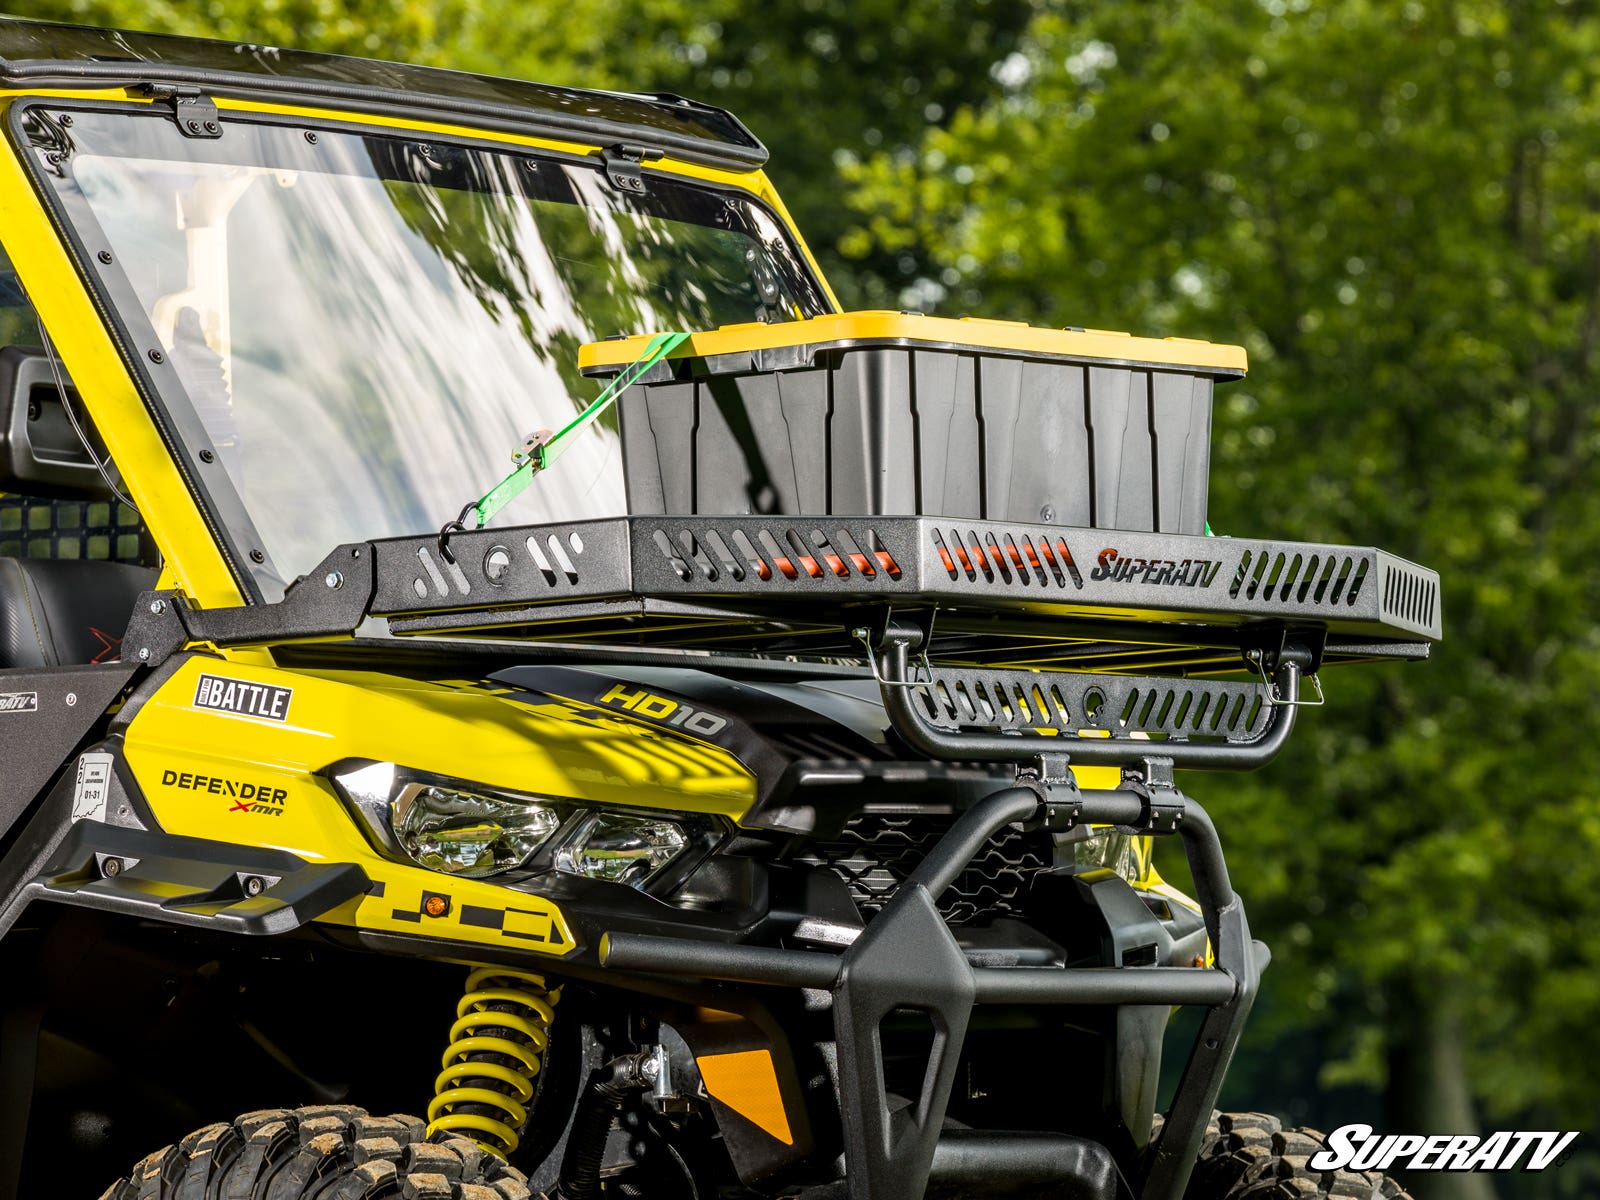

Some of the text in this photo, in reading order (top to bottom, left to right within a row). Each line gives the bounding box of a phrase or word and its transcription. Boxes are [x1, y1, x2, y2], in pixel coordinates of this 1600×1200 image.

[1091, 548, 1222, 588] SUPERATV
[208, 679, 287, 717] BATTLE
[600, 684, 727, 736] HD10
[84, 790, 100, 800] 01-31
[161, 770, 288, 805] DEFENDER
